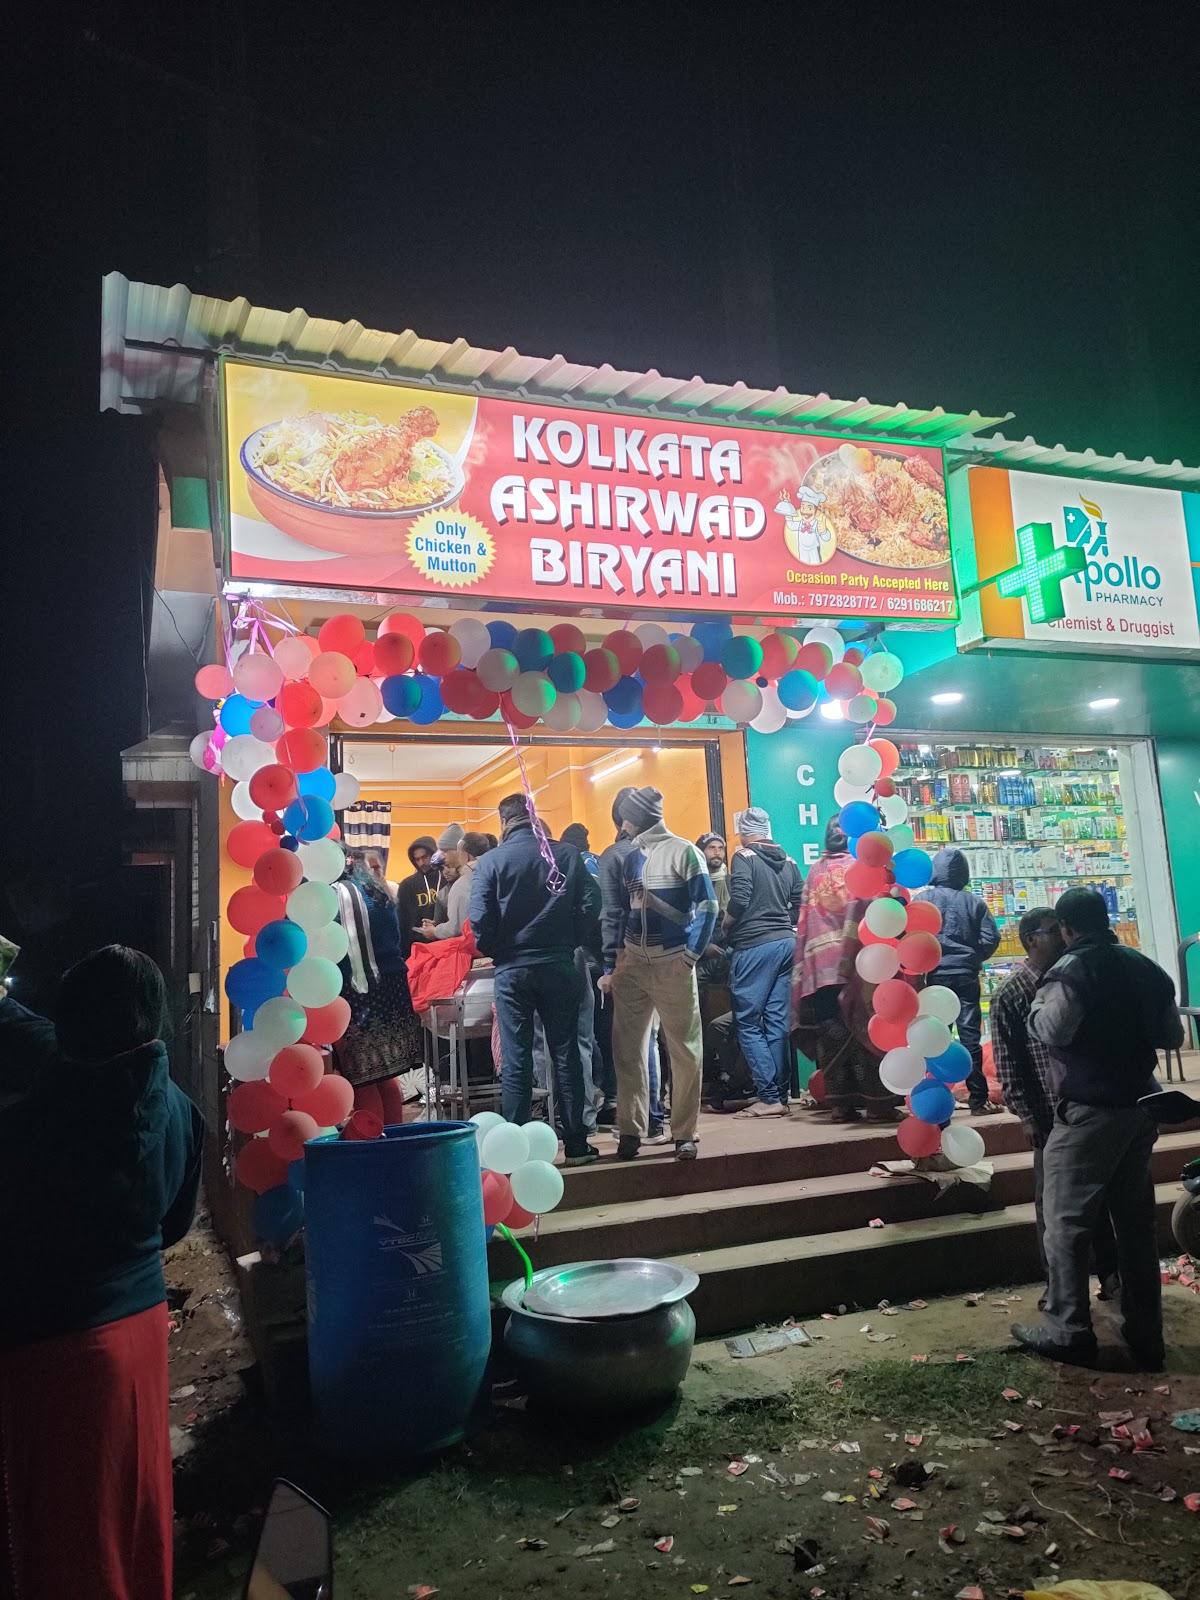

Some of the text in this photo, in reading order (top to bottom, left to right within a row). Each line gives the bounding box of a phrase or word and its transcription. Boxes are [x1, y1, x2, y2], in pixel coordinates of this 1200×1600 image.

[512, 415, 742, 485] KOLKATA
[490, 475, 767, 541] ASHIRWAD
[436, 521, 466, 539] Only
[415, 537, 487, 556] Chicken &
[428, 556, 476, 573] Mutton
[529, 537, 738, 598] BIRYANI
[786, 569, 949, 592] Occasion Party Accepted Here
[1074, 556, 1160, 601] pollo
[773, 591, 805, 606] Mob.:
[809, 593, 877, 609] 7972828772
[887, 597, 953, 613] 6291686217
[1096, 592, 1163, 607] PHARMACY
[1106, 618, 1115, 631] &
[1120, 619, 1175, 638] Druggist
